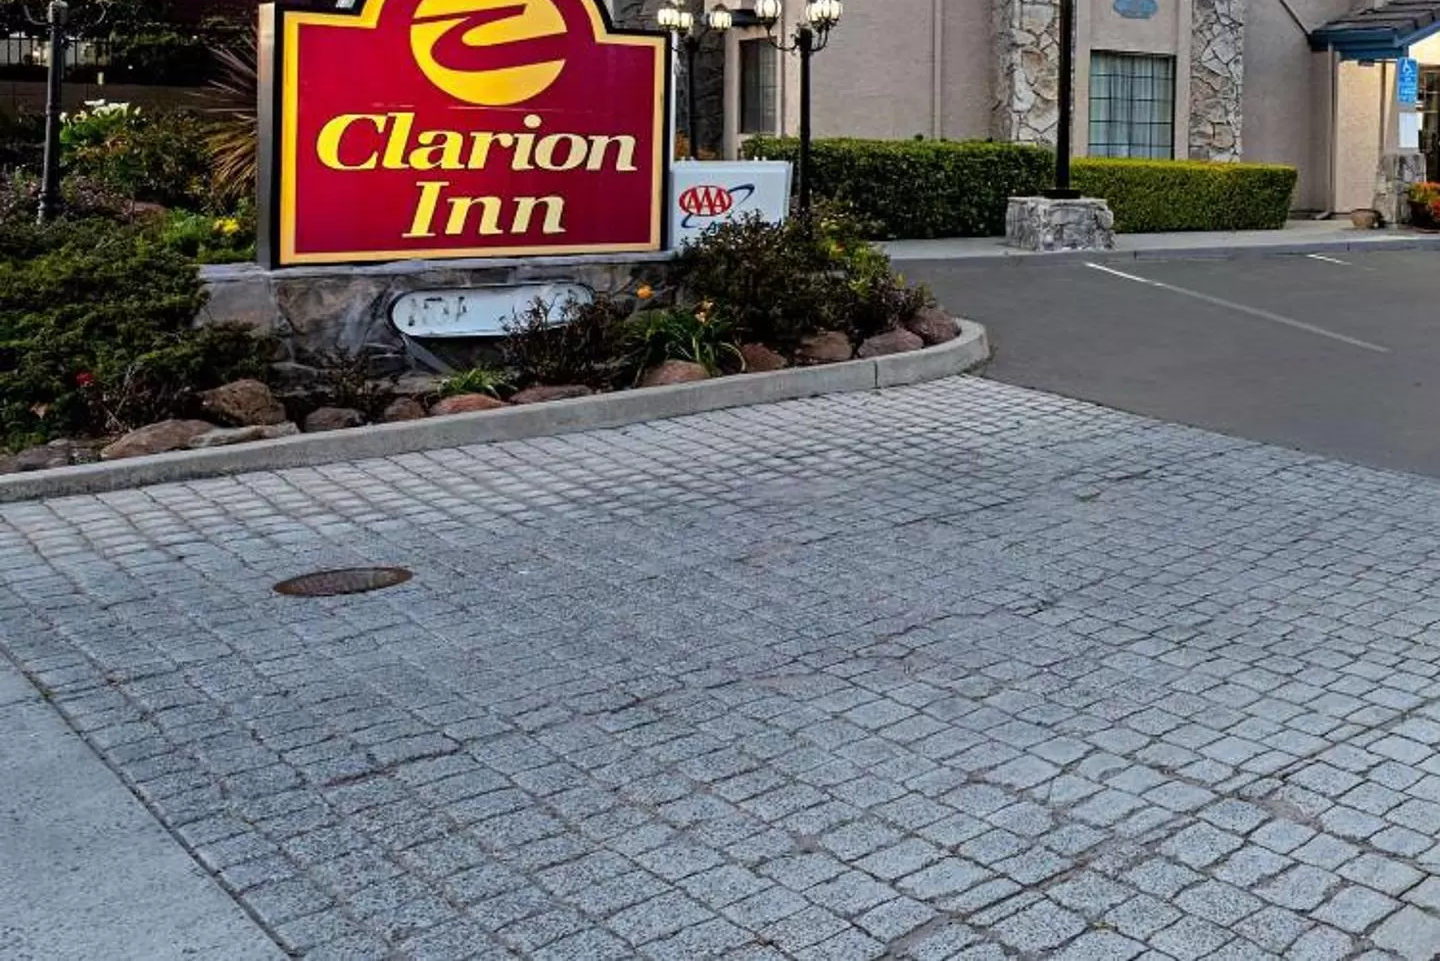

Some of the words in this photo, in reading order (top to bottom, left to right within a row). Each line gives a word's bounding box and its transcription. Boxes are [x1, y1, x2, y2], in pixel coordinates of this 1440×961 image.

[316, 112, 638, 171] Clarion
[402, 181, 566, 238] Inn
[683, 186, 730, 216] AAA
